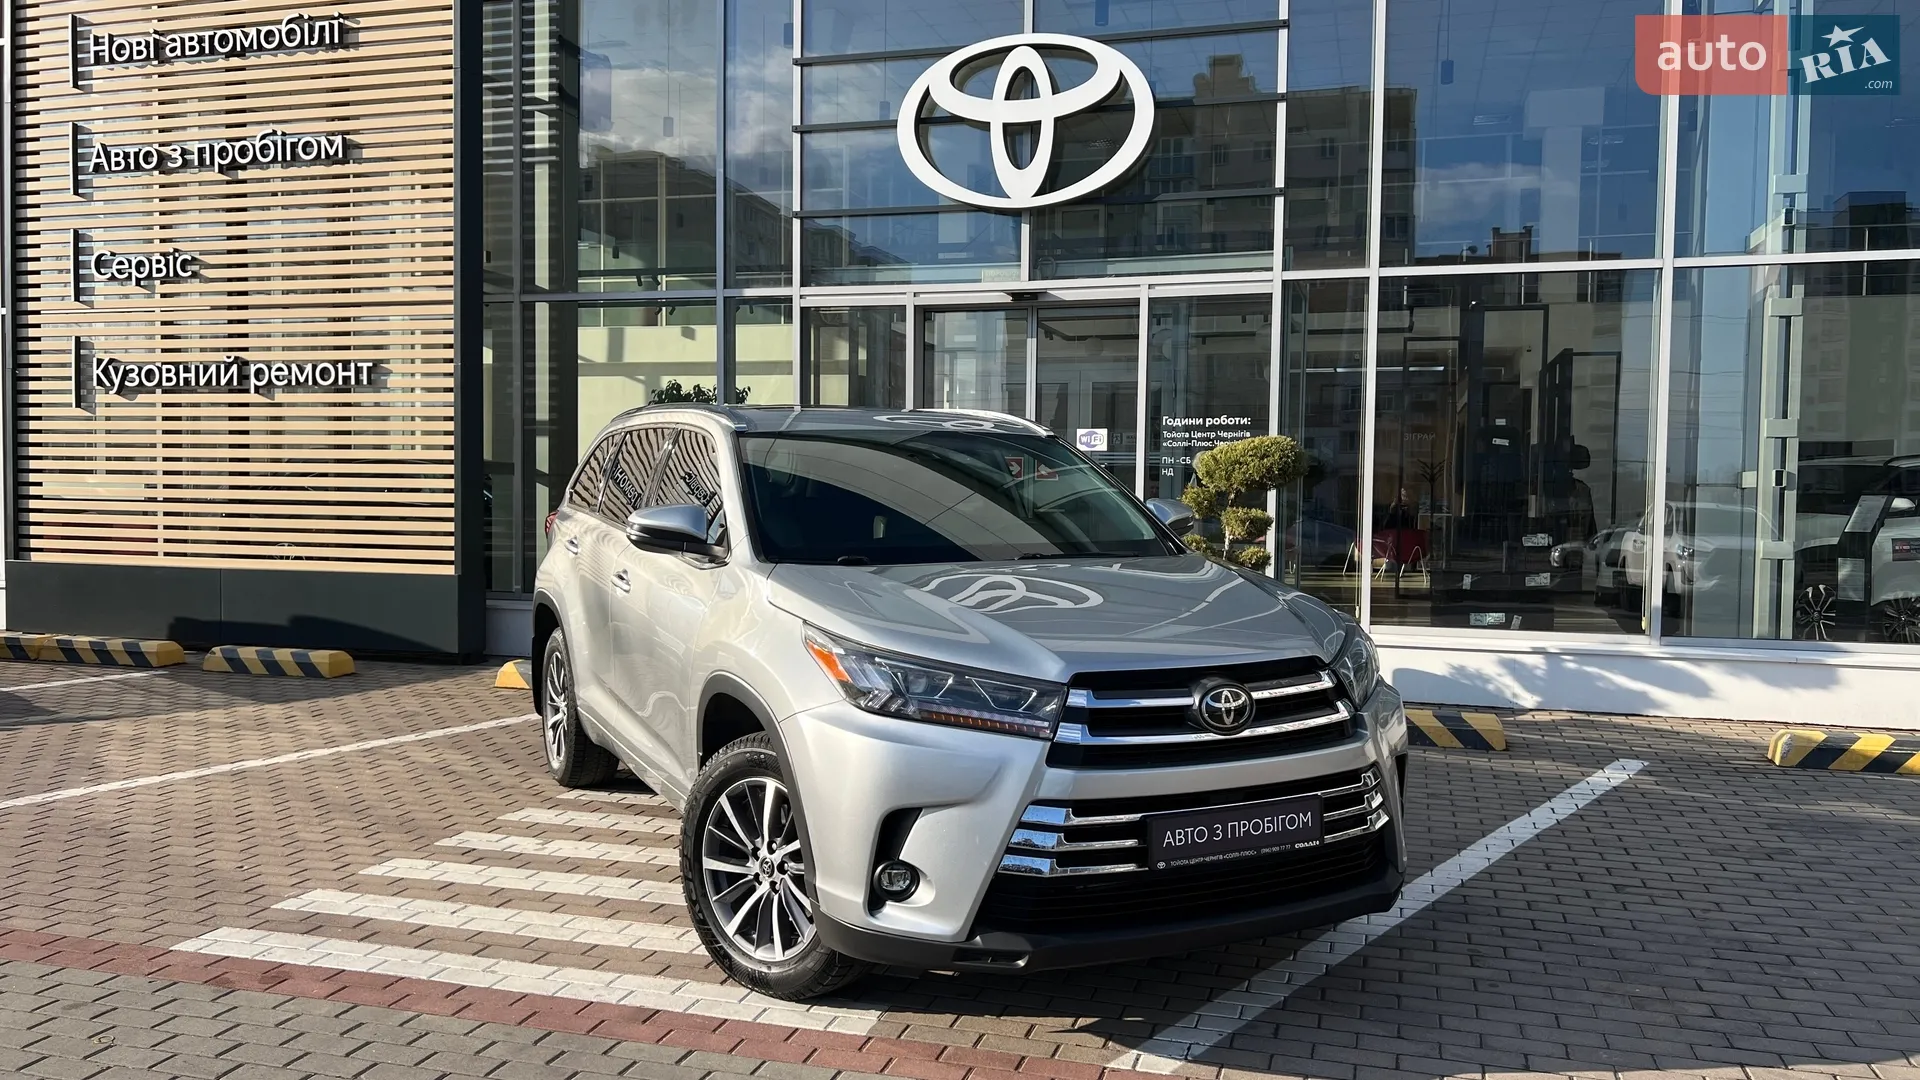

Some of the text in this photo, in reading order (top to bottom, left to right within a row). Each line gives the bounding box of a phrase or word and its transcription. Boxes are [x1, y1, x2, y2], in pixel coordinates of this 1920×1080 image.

[89, 11, 341, 64] Нові автомобілі
[89, 129, 343, 173] Авто з пробігом
[91, 248, 192, 286] Сервіс
[92, 355, 373, 394] Кузовний ремонт
[1162, 415, 1251, 427] Години роботи:
[1191, 431, 1216, 439] Центр
[1163, 826, 1208, 847] АВТО
[1228, 811, 1312, 839] ПРОБІГОМ
